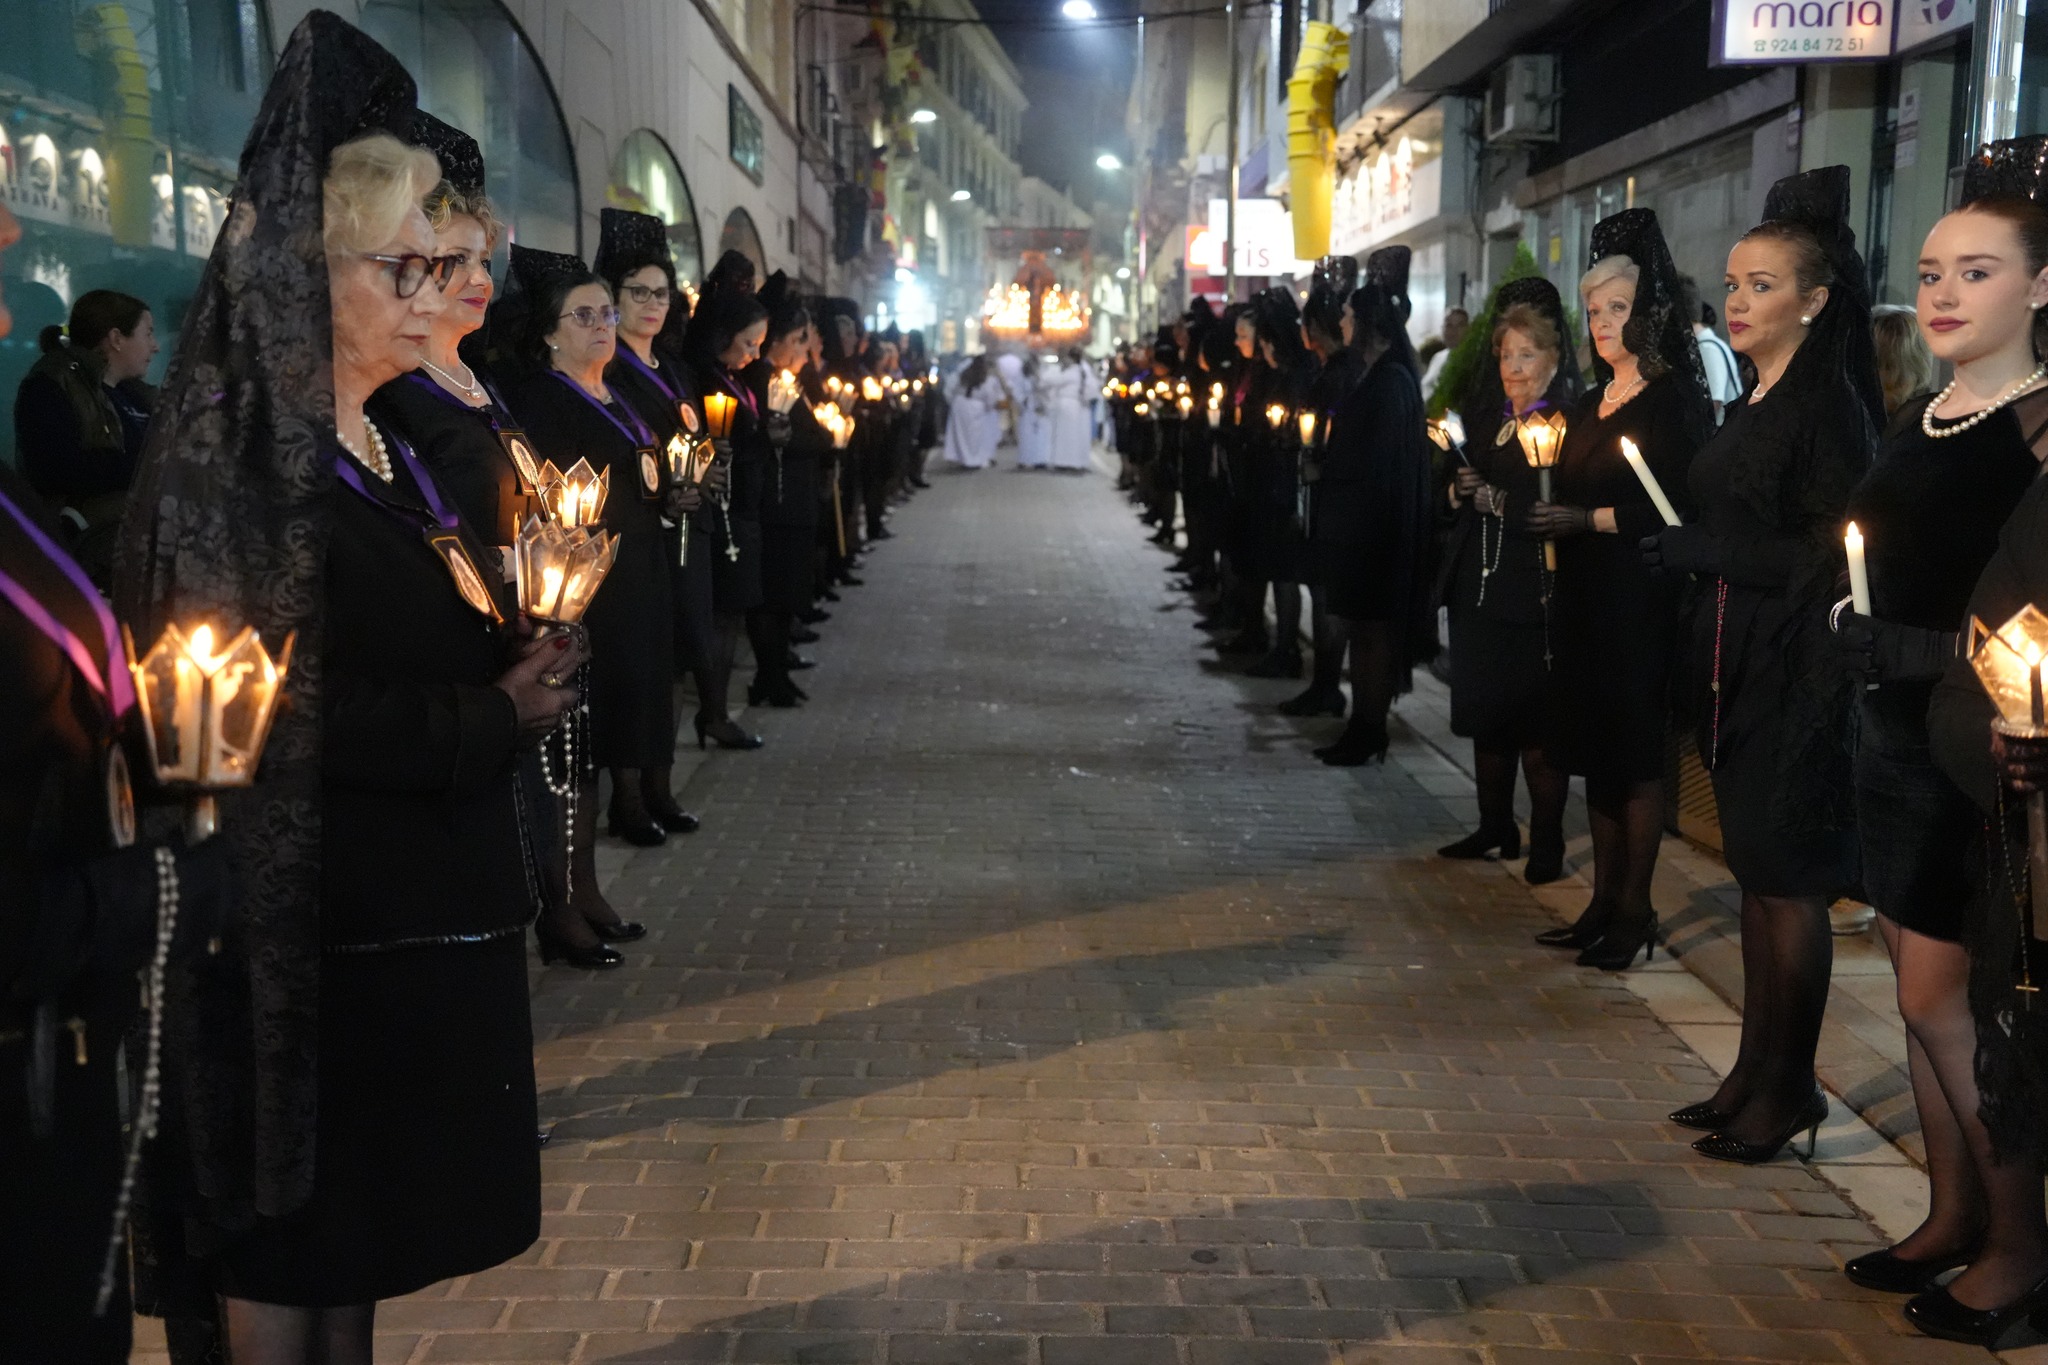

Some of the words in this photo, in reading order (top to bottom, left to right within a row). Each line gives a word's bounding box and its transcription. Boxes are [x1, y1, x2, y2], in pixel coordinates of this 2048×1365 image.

[1770, 38, 1798, 52] 924
[1802, 38, 1821, 51] 84
[1826, 38, 1844, 51] 72
[1848, 38, 1865, 51] 51
